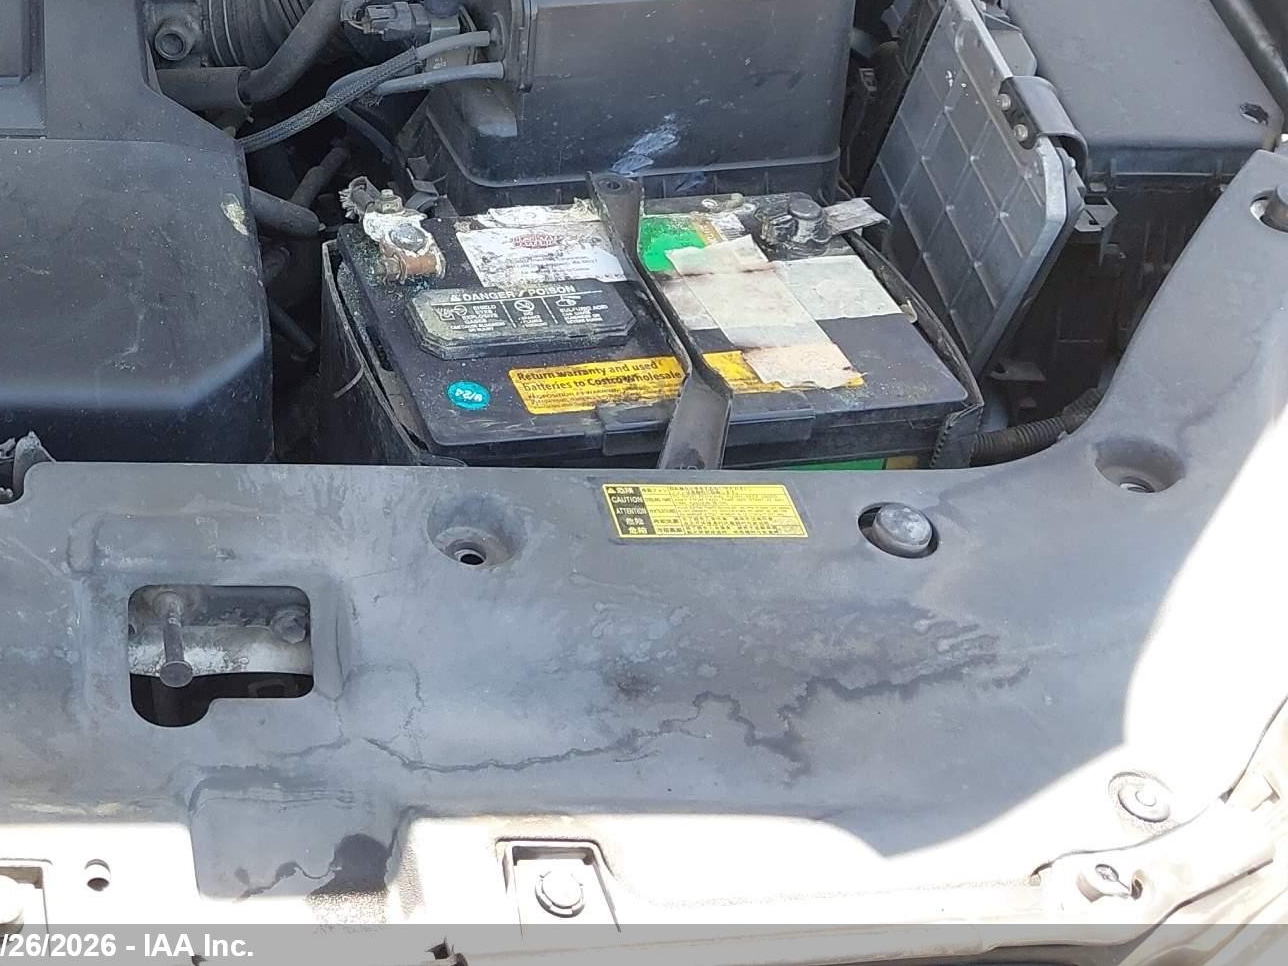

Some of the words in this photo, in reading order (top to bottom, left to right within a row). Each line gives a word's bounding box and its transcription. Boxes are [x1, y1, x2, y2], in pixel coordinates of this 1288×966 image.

[463, 291, 515, 301] DANGER
[528, 285, 576, 296] POISON
[517, 369, 555, 381] Return
[556, 365, 606, 380] warranty
[608, 363, 630, 374] and
[632, 361, 658, 371] used
[523, 380, 573, 392] batteries
[575, 378, 586, 388] to
[616, 507, 647, 515] ATTENTION
